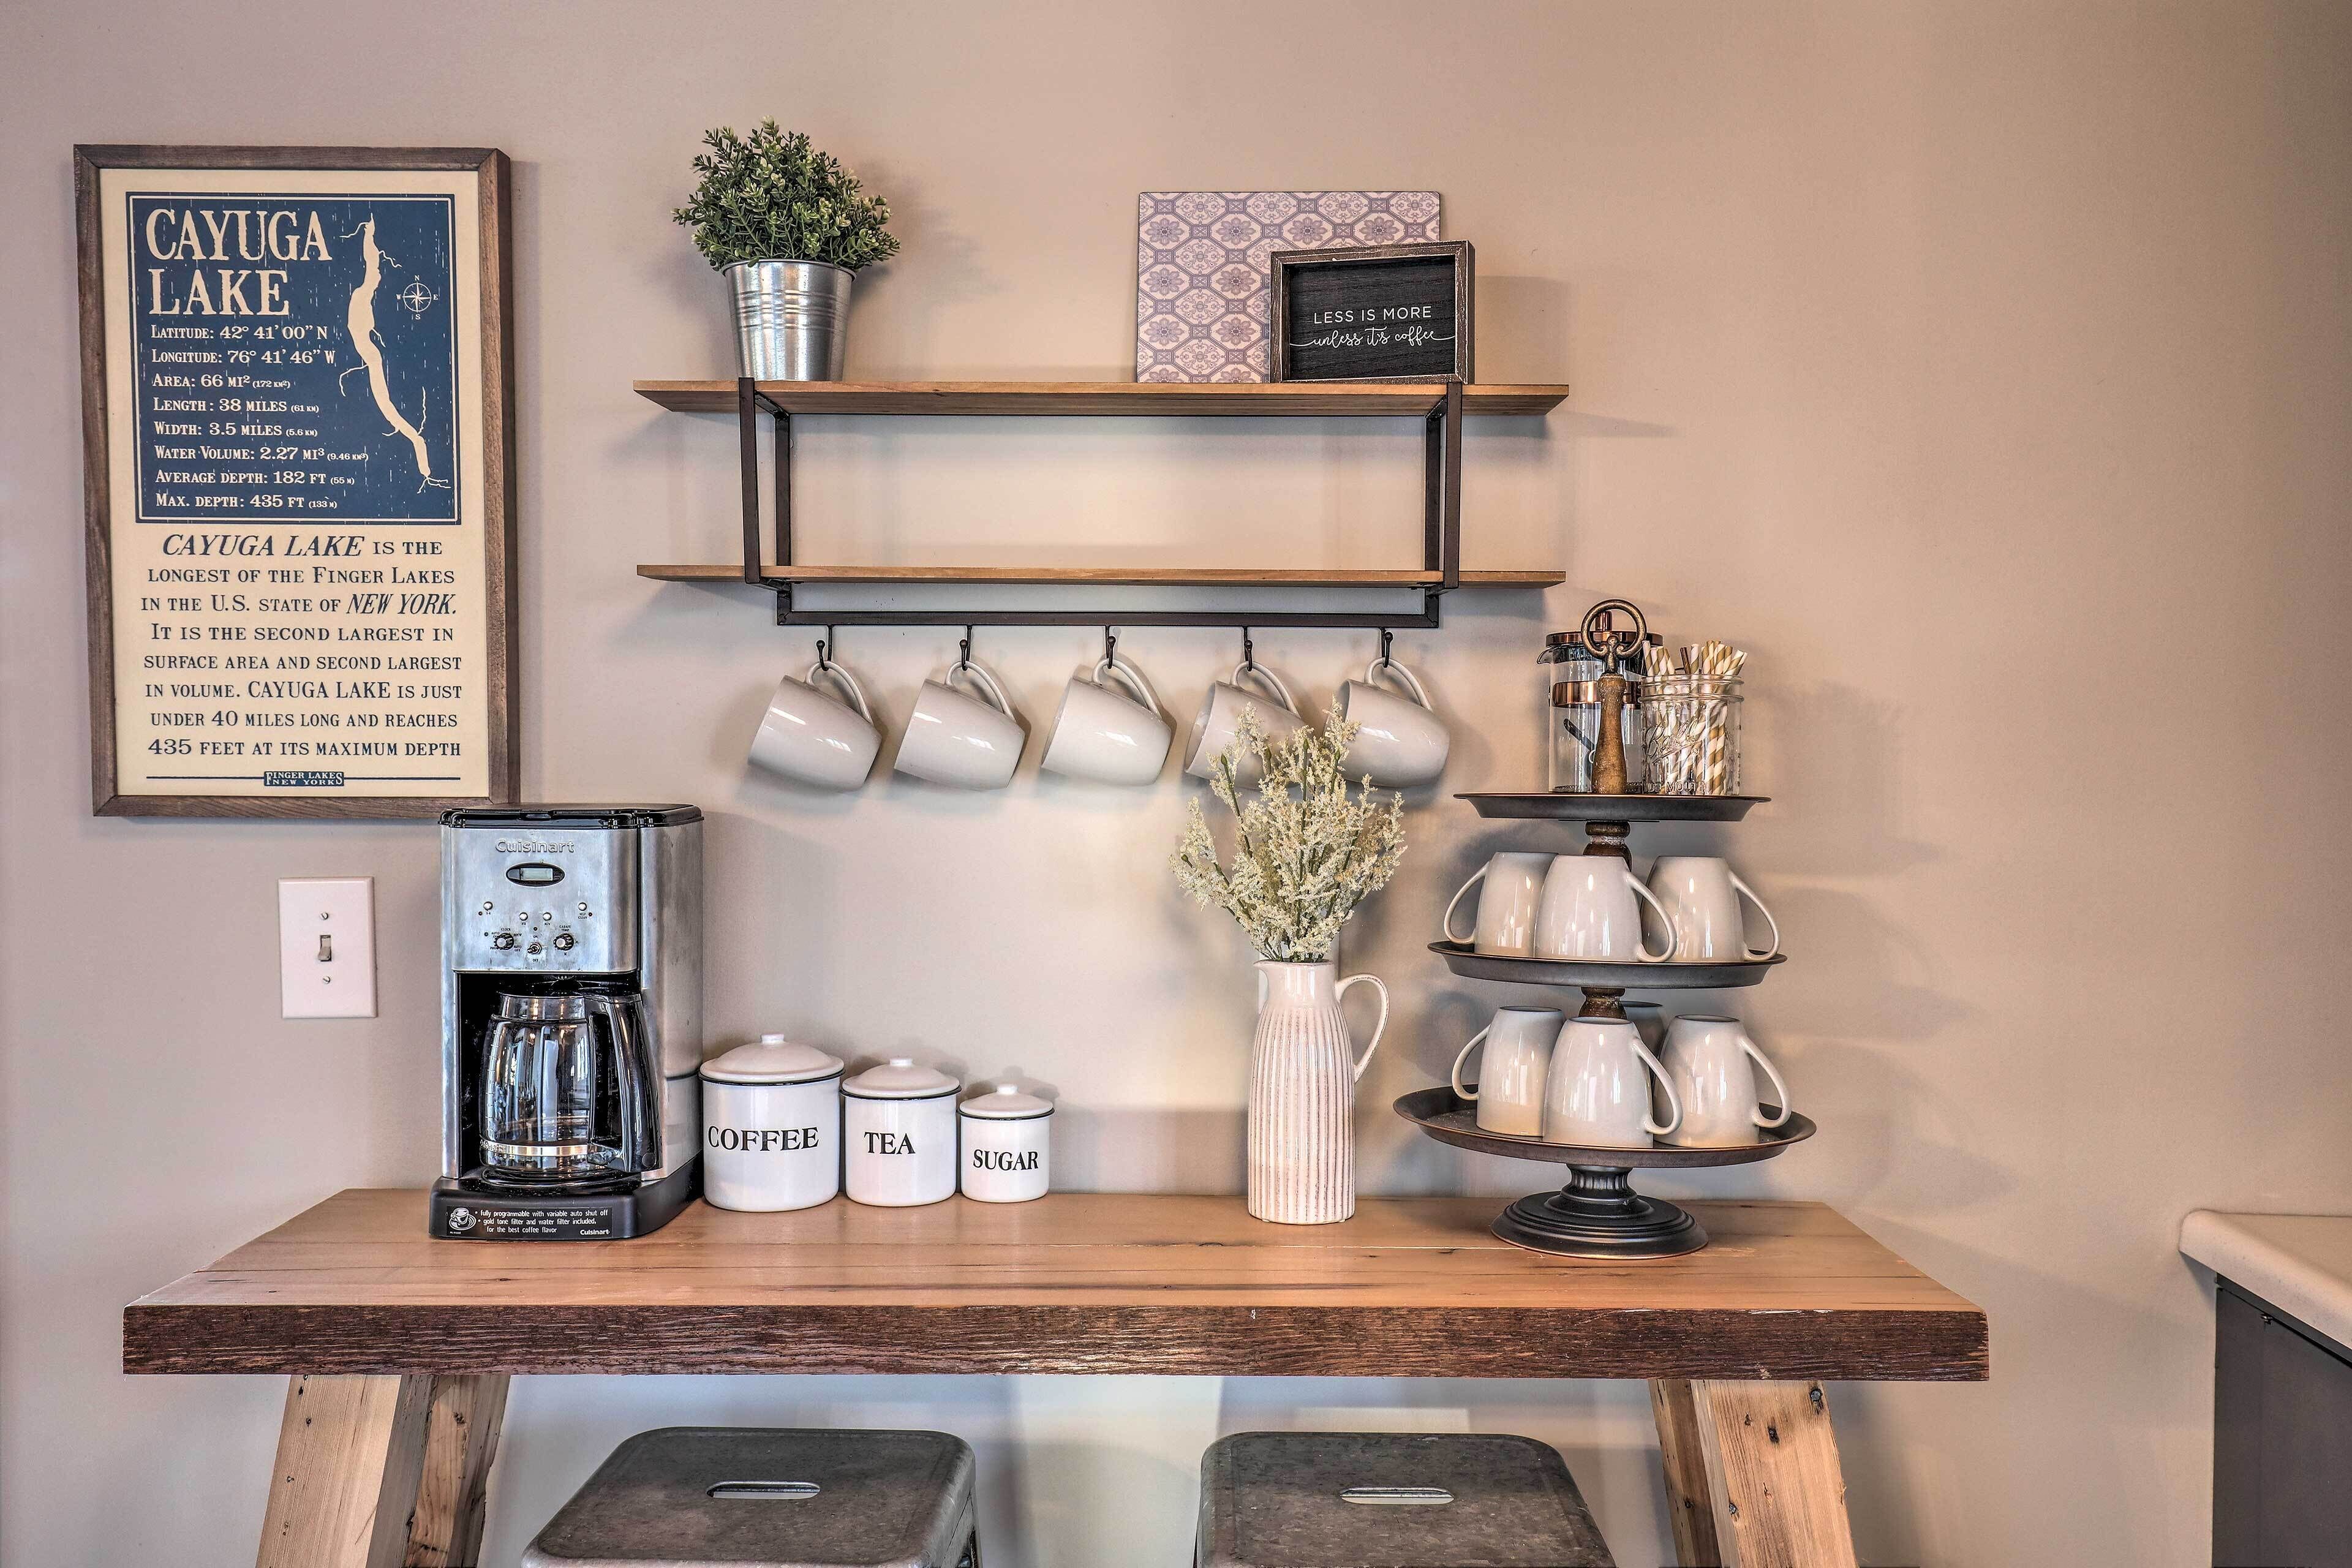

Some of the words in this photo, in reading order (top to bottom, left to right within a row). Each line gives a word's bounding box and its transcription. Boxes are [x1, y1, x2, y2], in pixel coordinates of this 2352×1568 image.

[146, 209, 333, 260] CAYUGA
[148, 269, 289, 315] LAKE
[1314, 311, 1354, 324] LESS
[1362, 309, 1375, 322] IS
[1383, 306, 1432, 320] MORE
[151, 325, 214, 339] LATITUDE:
[220, 326, 249, 339] 42°
[317, 326, 327, 339] N
[1310, 330, 1363, 348] unless
[1395, 326, 1437, 346] coffee
[152, 349, 222, 363] LONGITUDE:
[227, 350, 256, 363] 76°
[324, 350, 336, 364] W
[153, 373, 195, 387] AREA:
[201, 374, 223, 387] 66
[219, 398, 241, 411] 38
[246, 401, 287, 412] MILES
[154, 421, 202, 435] WIDTH:
[209, 423, 236, 435] 3.5
[241, 425, 282, 435] MILES
[154, 445, 196, 459] WATER
[200, 446, 254, 460] VOLUME:
[260, 447, 298, 460] 2.27
[156, 470, 216, 484] AVERAGE
[221, 473, 268, 484] DEPTH:
[273, 471, 305, 484] 182
[309, 473, 326, 484] FT
[156, 493, 190, 507] MAX.
[195, 496, 244, 508] DEPTH:
[250, 495, 283, 508] 435
[288, 497, 304, 508] FT
[162, 534, 274, 556] CAYUGA
[284, 535, 365, 556] LAKE
[372, 541, 394, 554] IS
[402, 541, 442, 555] THE
[148, 569, 230, 582] LONGEST
[238, 570, 260, 582] OF
[268, 570, 304, 582] THE
[312, 567, 383, 583] FINGER
[391, 567, 454, 584] LAKES
[141, 598, 160, 611] IN
[167, 598, 202, 611] THE
[211, 594, 250, 611] U.S.
[259, 598, 312, 612] STATE
[320, 599, 341, 612] OF
[345, 594, 394, 614] NEW
[398, 594, 456, 614] YORK.
[151, 623, 172, 639] IT
[179, 627, 201, 640] IS
[208, 627, 246, 640] THE
[254, 627, 330, 641] SECOND
[338, 628, 424, 641] LARGEST
[432, 628, 453, 641] IN
[144, 655, 218, 669] SURFACE
[225, 656, 270, 669] AREA
[276, 656, 309, 669] AND
[316, 657, 381, 669] SECOND
[388, 657, 462, 669] LARGEST
[145, 684, 164, 697] IN
[170, 684, 240, 698] VOLUME.
[247, 681, 329, 698] CAYUGA
[336, 682, 390, 698] LAKE
[398, 685, 415, 698] IS
[421, 685, 462, 699] JUST
[151, 713, 205, 726] UNDER
[211, 710, 238, 726] 40
[246, 714, 295, 726] MILES
[301, 714, 339, 727] LONG
[347, 714, 379, 727] AND
[385, 714, 458, 727] REACHES
[148, 739, 192, 755] 435
[200, 742, 244, 755] FEET
[252, 742, 273, 755] AT
[280, 742, 309, 755] ITS
[316, 742, 398, 756] MAXIMUM
[404, 743, 461, 756] DEPTH
[266, 772, 304, 785] FINGER
[308, 772, 342, 785] LAKES
[496, 839, 575, 853] Cuisinart
[707, 1126, 820, 1152] COFFEE
[864, 1131, 916, 1155] TEA
[973, 1148, 1039, 1171] SUGAR
